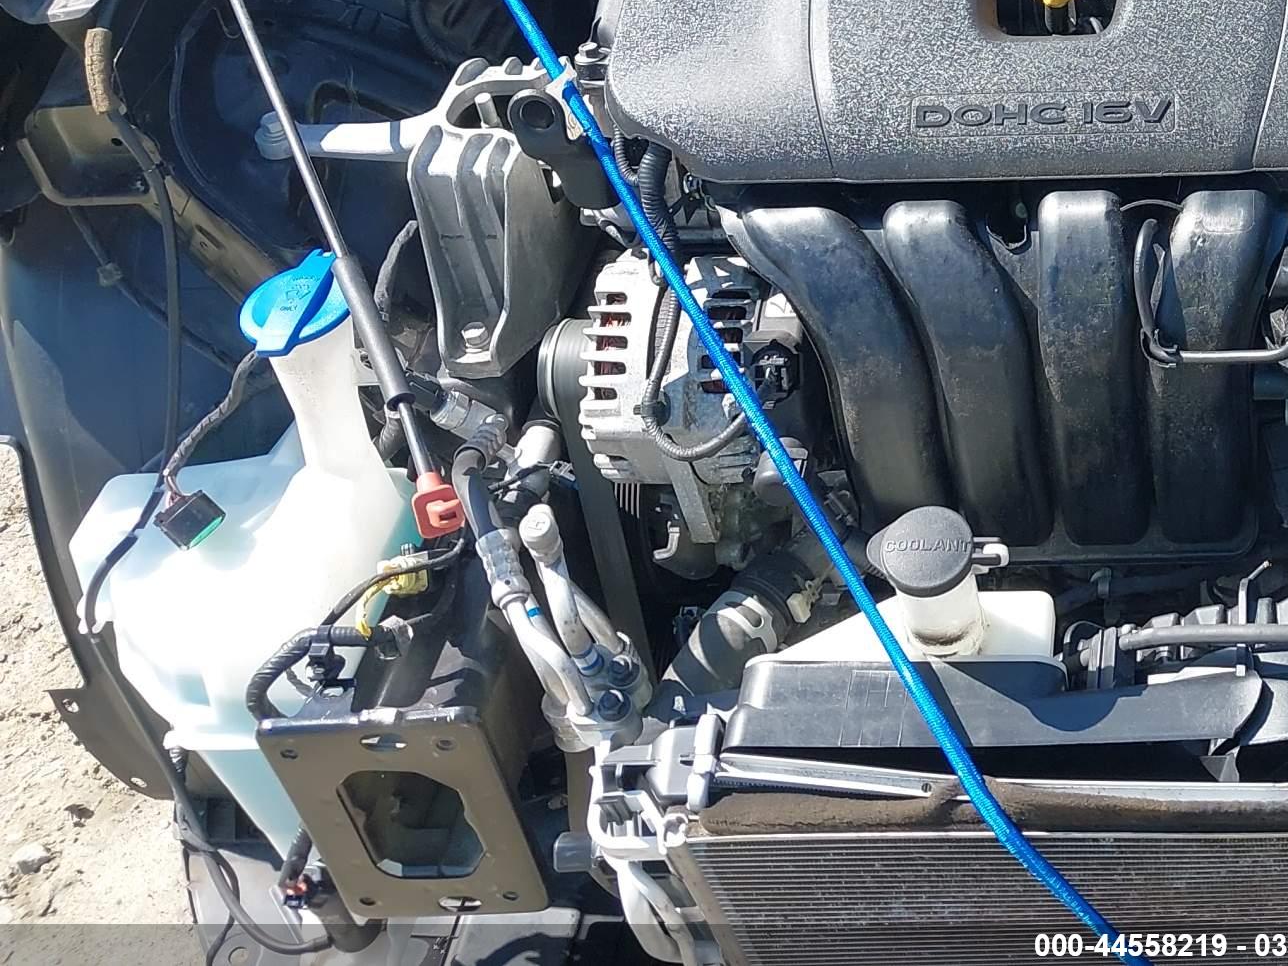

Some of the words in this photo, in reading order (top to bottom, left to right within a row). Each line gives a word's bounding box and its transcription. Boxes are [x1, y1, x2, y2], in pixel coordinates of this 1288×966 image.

[916, 105, 1067, 128] DOHC
[1084, 100, 1174, 125] 16V
[885, 538, 972, 553] COOLANT
